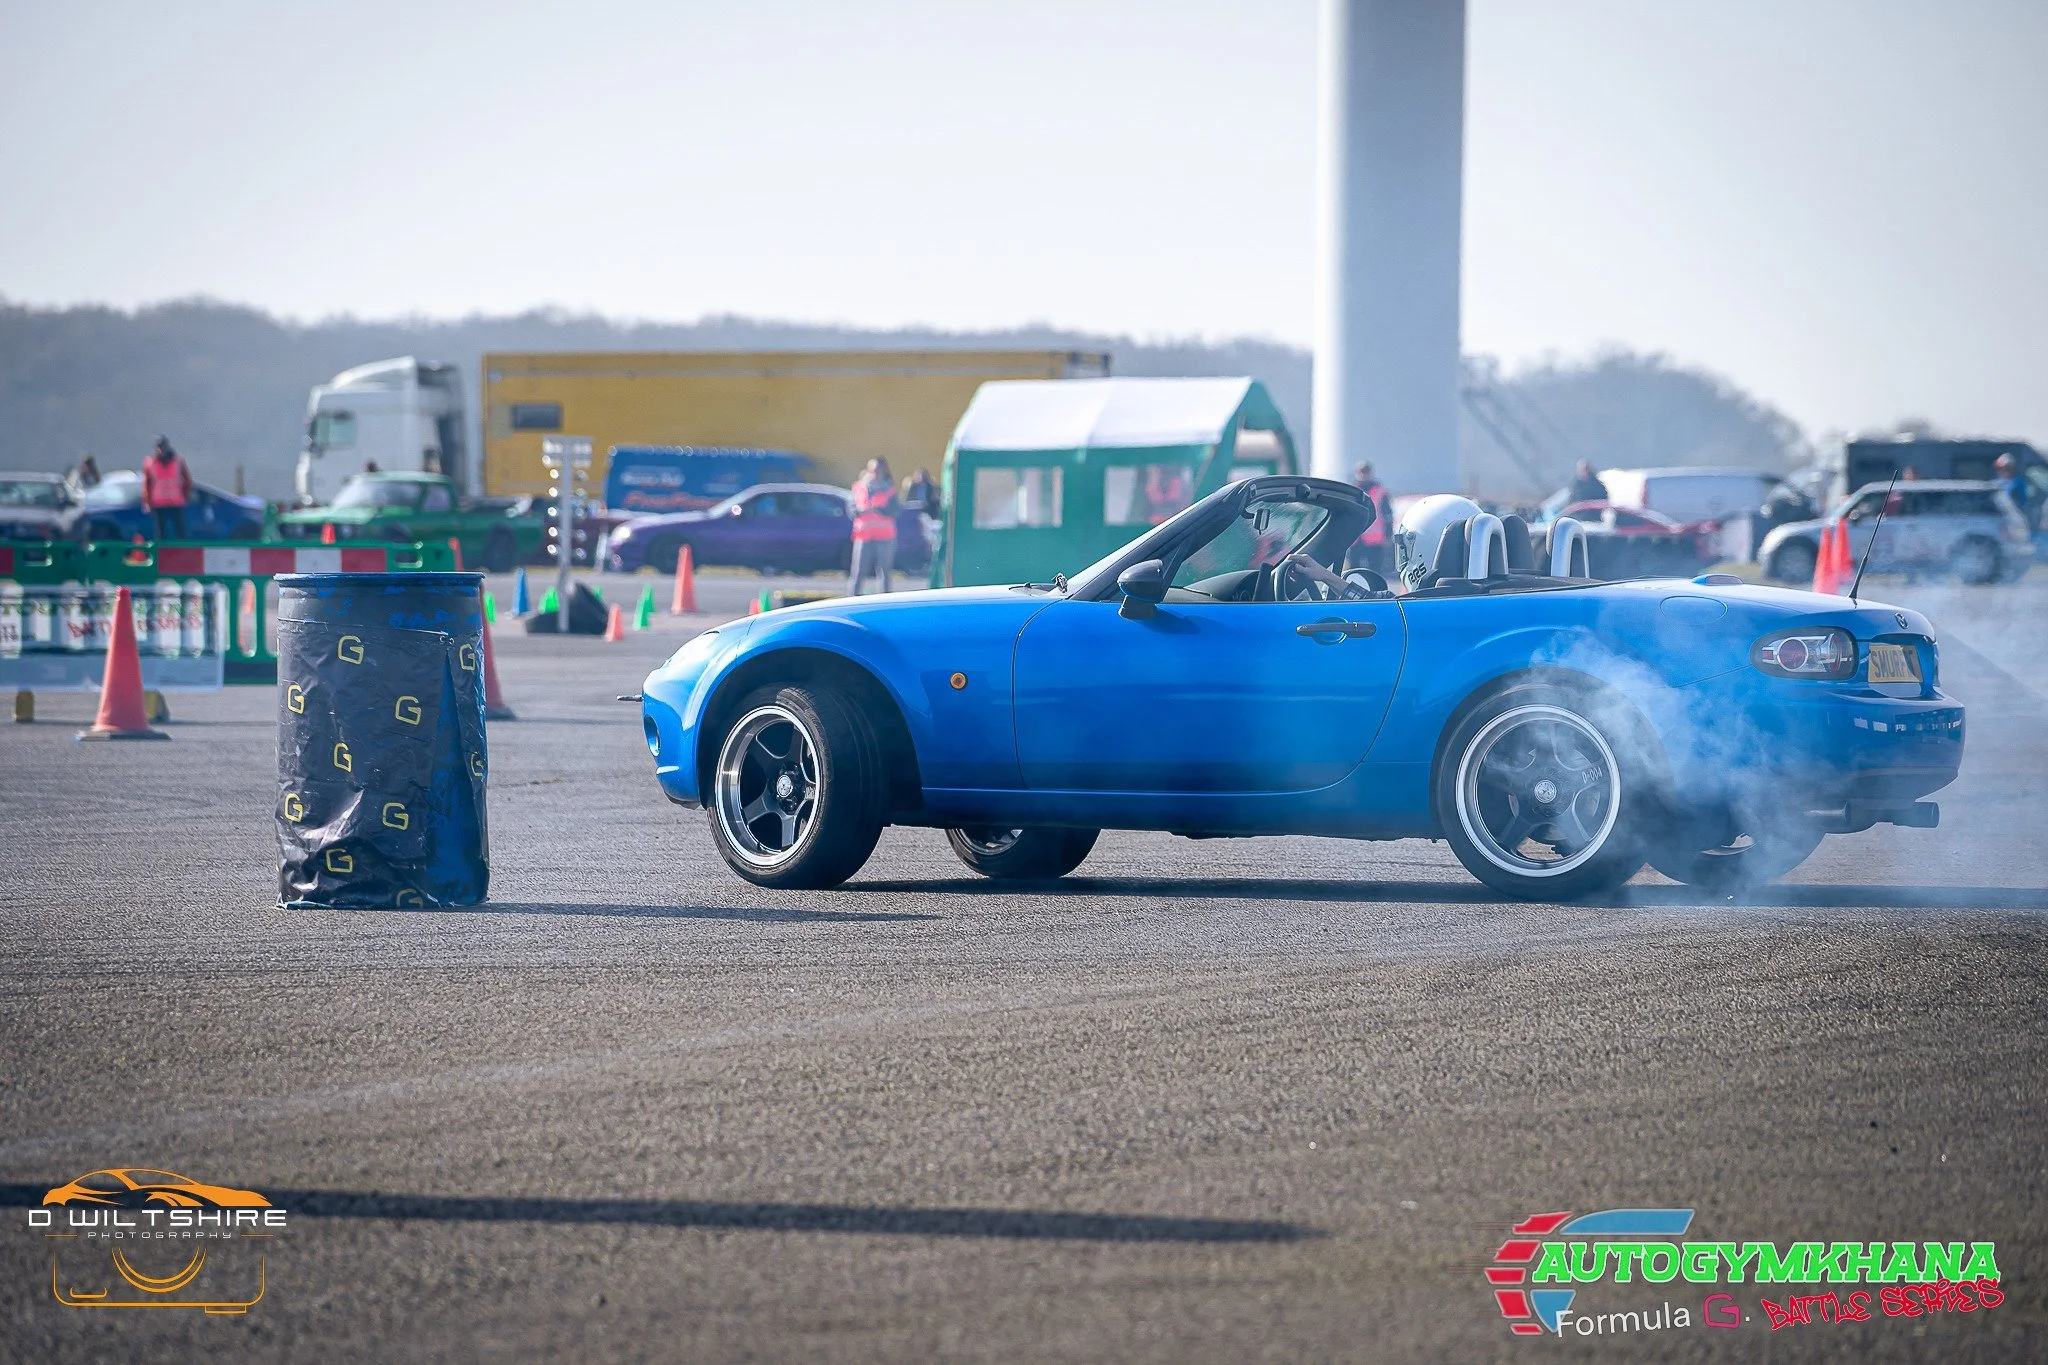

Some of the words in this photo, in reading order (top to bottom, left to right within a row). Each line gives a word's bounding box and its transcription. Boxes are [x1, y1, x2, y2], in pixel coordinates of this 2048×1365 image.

[338, 634, 365, 665] G
[458, 643, 476, 671] G
[287, 684, 305, 715] G
[395, 695, 422, 726] G
[333, 742, 353, 773] G
[283, 793, 304, 824] G
[382, 802, 409, 831] G
[325, 848, 353, 874] G
